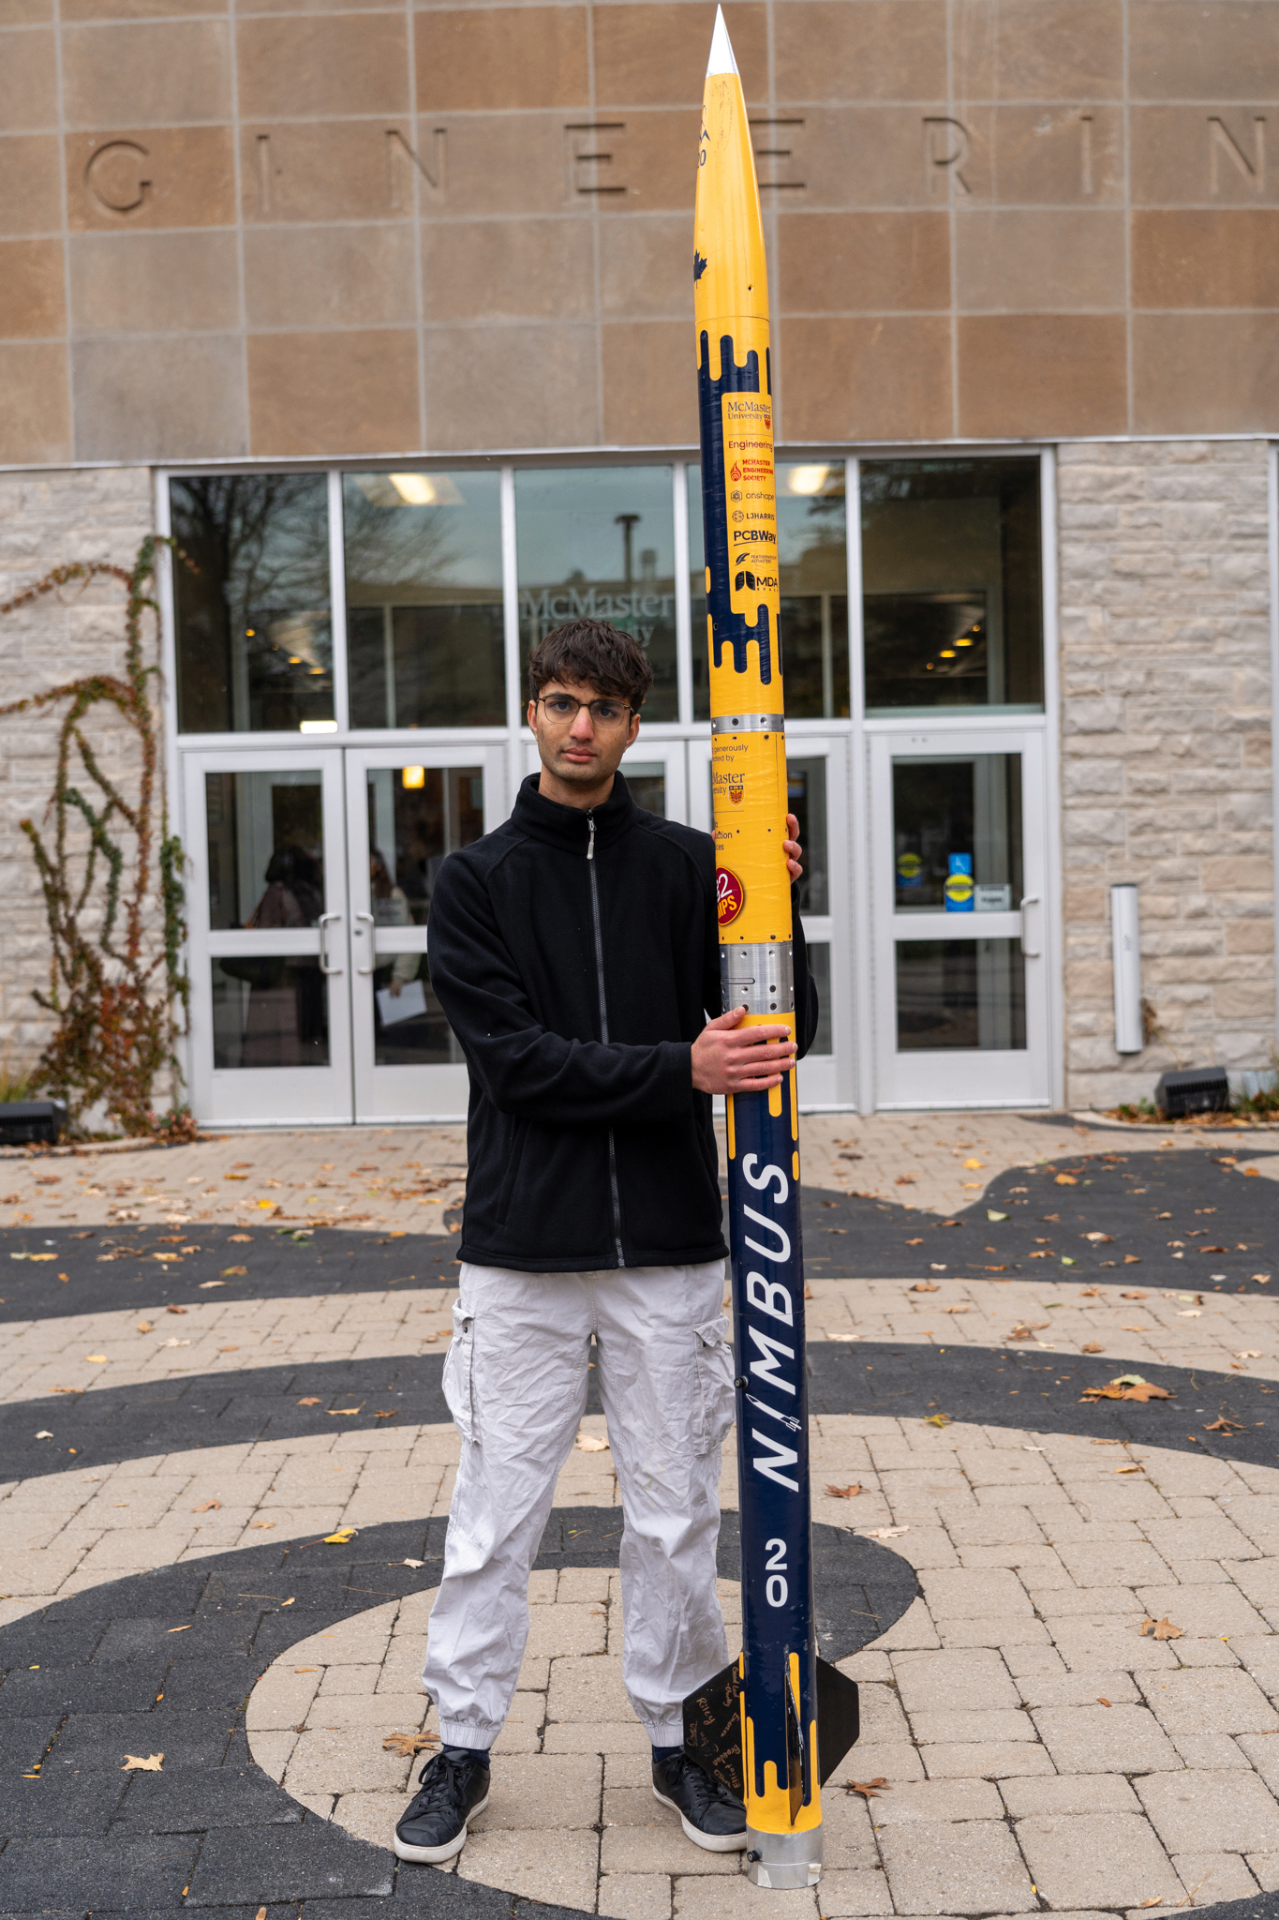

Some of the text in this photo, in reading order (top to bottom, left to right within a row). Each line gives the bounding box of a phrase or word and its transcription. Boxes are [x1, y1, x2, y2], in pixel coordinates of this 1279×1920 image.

[728, 402, 771, 413] McMaster
[728, 413, 763, 421] University
[729, 441, 772, 452] Engineering
[746, 492, 774, 501] onshape
[747, 513, 774, 521] L3HARRIS
[734, 531, 776, 544] PCBWay
[519, 586, 674, 621] McMaster
[714, 744, 748, 754] generously
[725, 754, 735, 762] by
[696, 1697, 716, 1726] Riley
